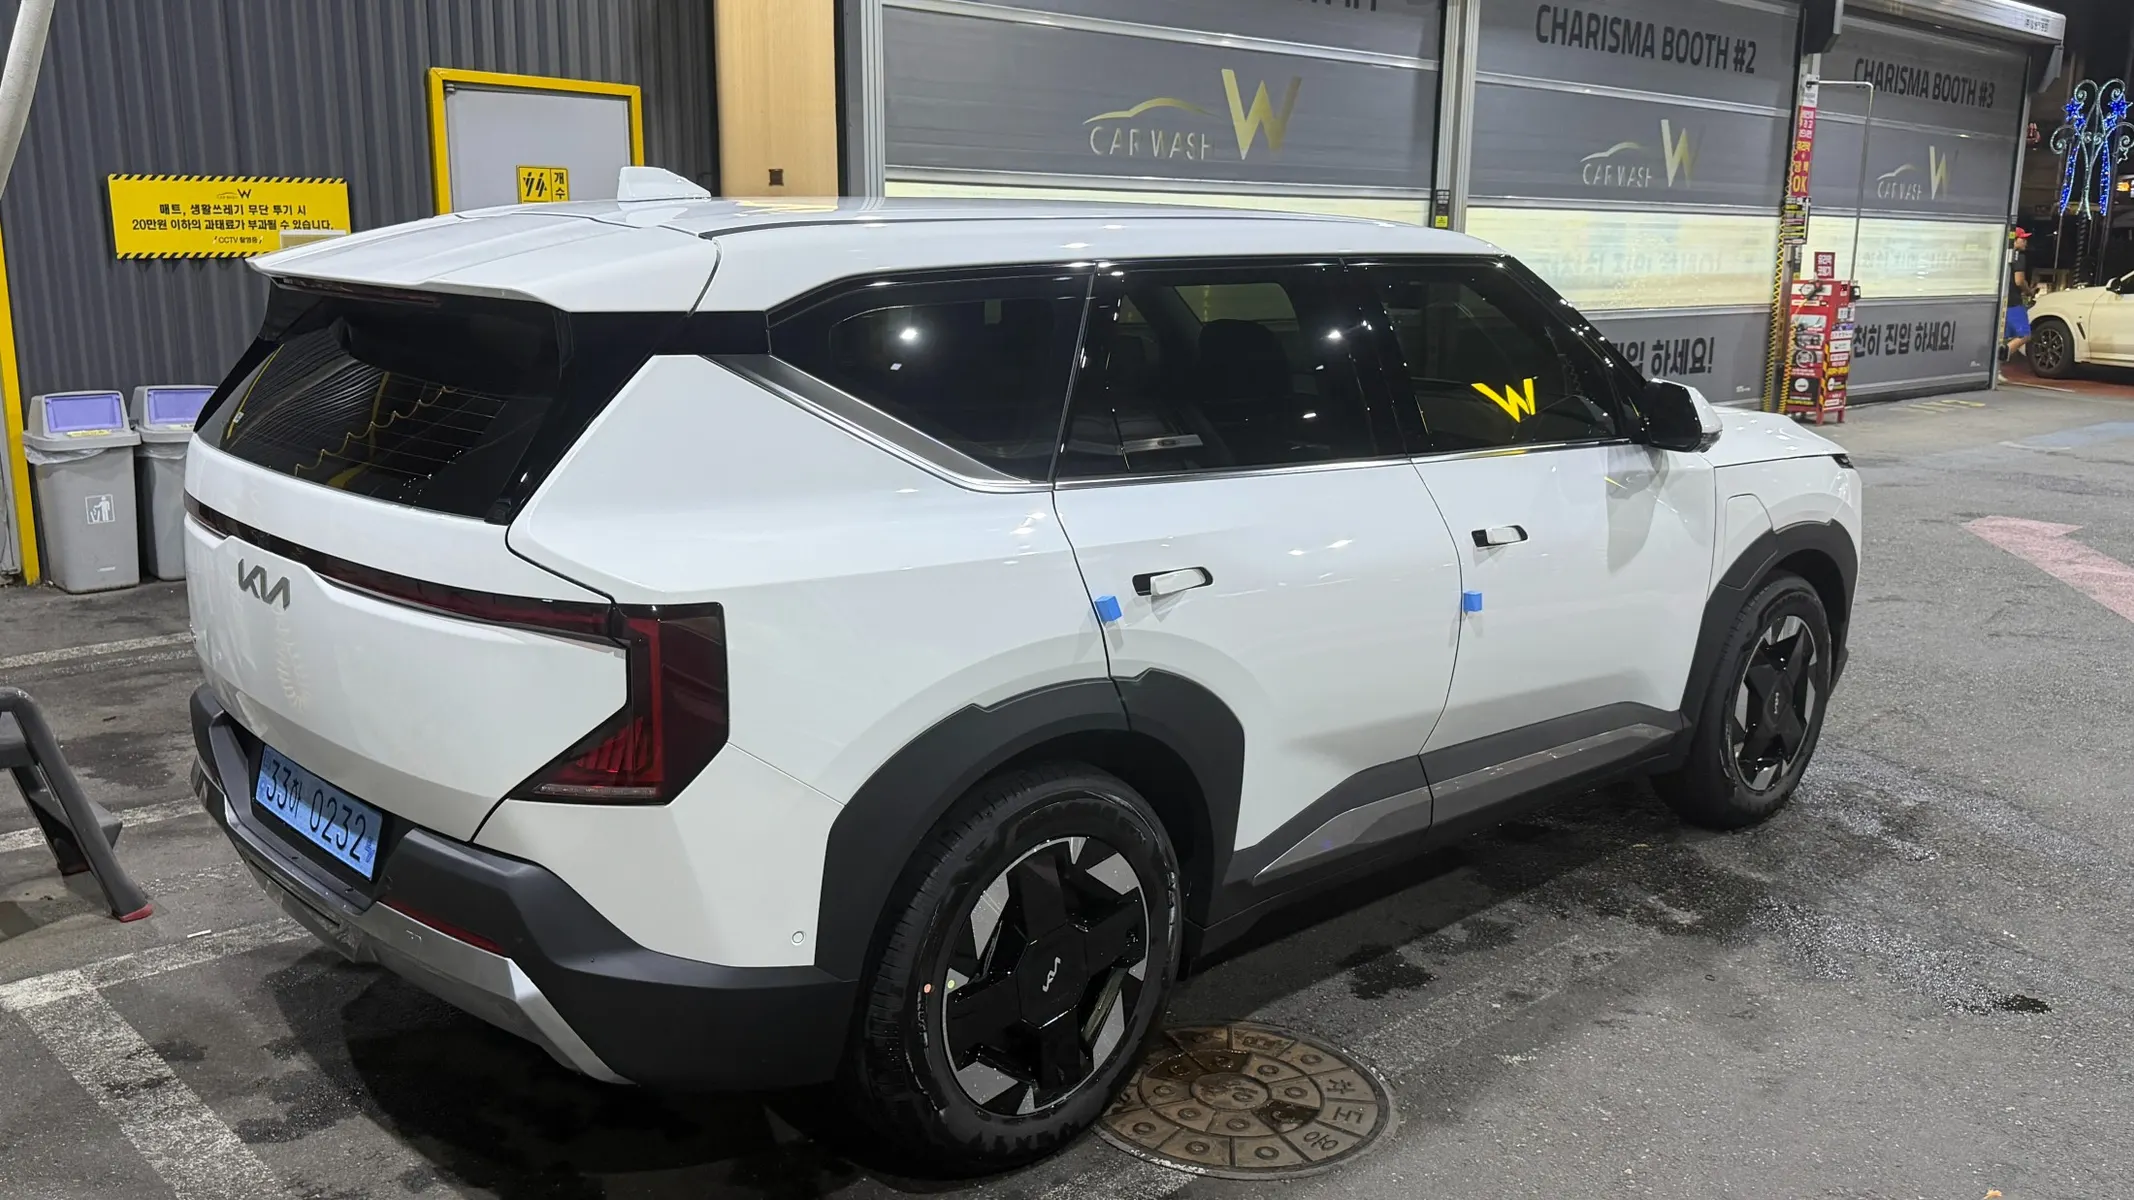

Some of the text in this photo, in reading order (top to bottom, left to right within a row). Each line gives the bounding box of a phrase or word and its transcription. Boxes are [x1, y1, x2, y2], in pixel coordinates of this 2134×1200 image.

[1535, 4, 1757, 74] CHARISMA BOOTH #2
[1854, 58, 1996, 109] CHARISMA BOOTH #3
[1089, 126, 1215, 161] CAR WASH
[237, 188, 252, 199] W
[1792, 175, 1808, 193] OK
[132, 219, 334, 231] 20만원 이하의 과태료가 부과될 수 있습니다.
[159, 203, 307, 216] 매트, 생활쓰레기 무단 투기 시
[218, 236, 239, 244] CCTV
[1884, 322, 1912, 355] 진입
[1914, 320, 1957, 352] 하세요!
[1651, 336, 1715, 377] 하세요!
[309, 788, 367, 862] 0232
